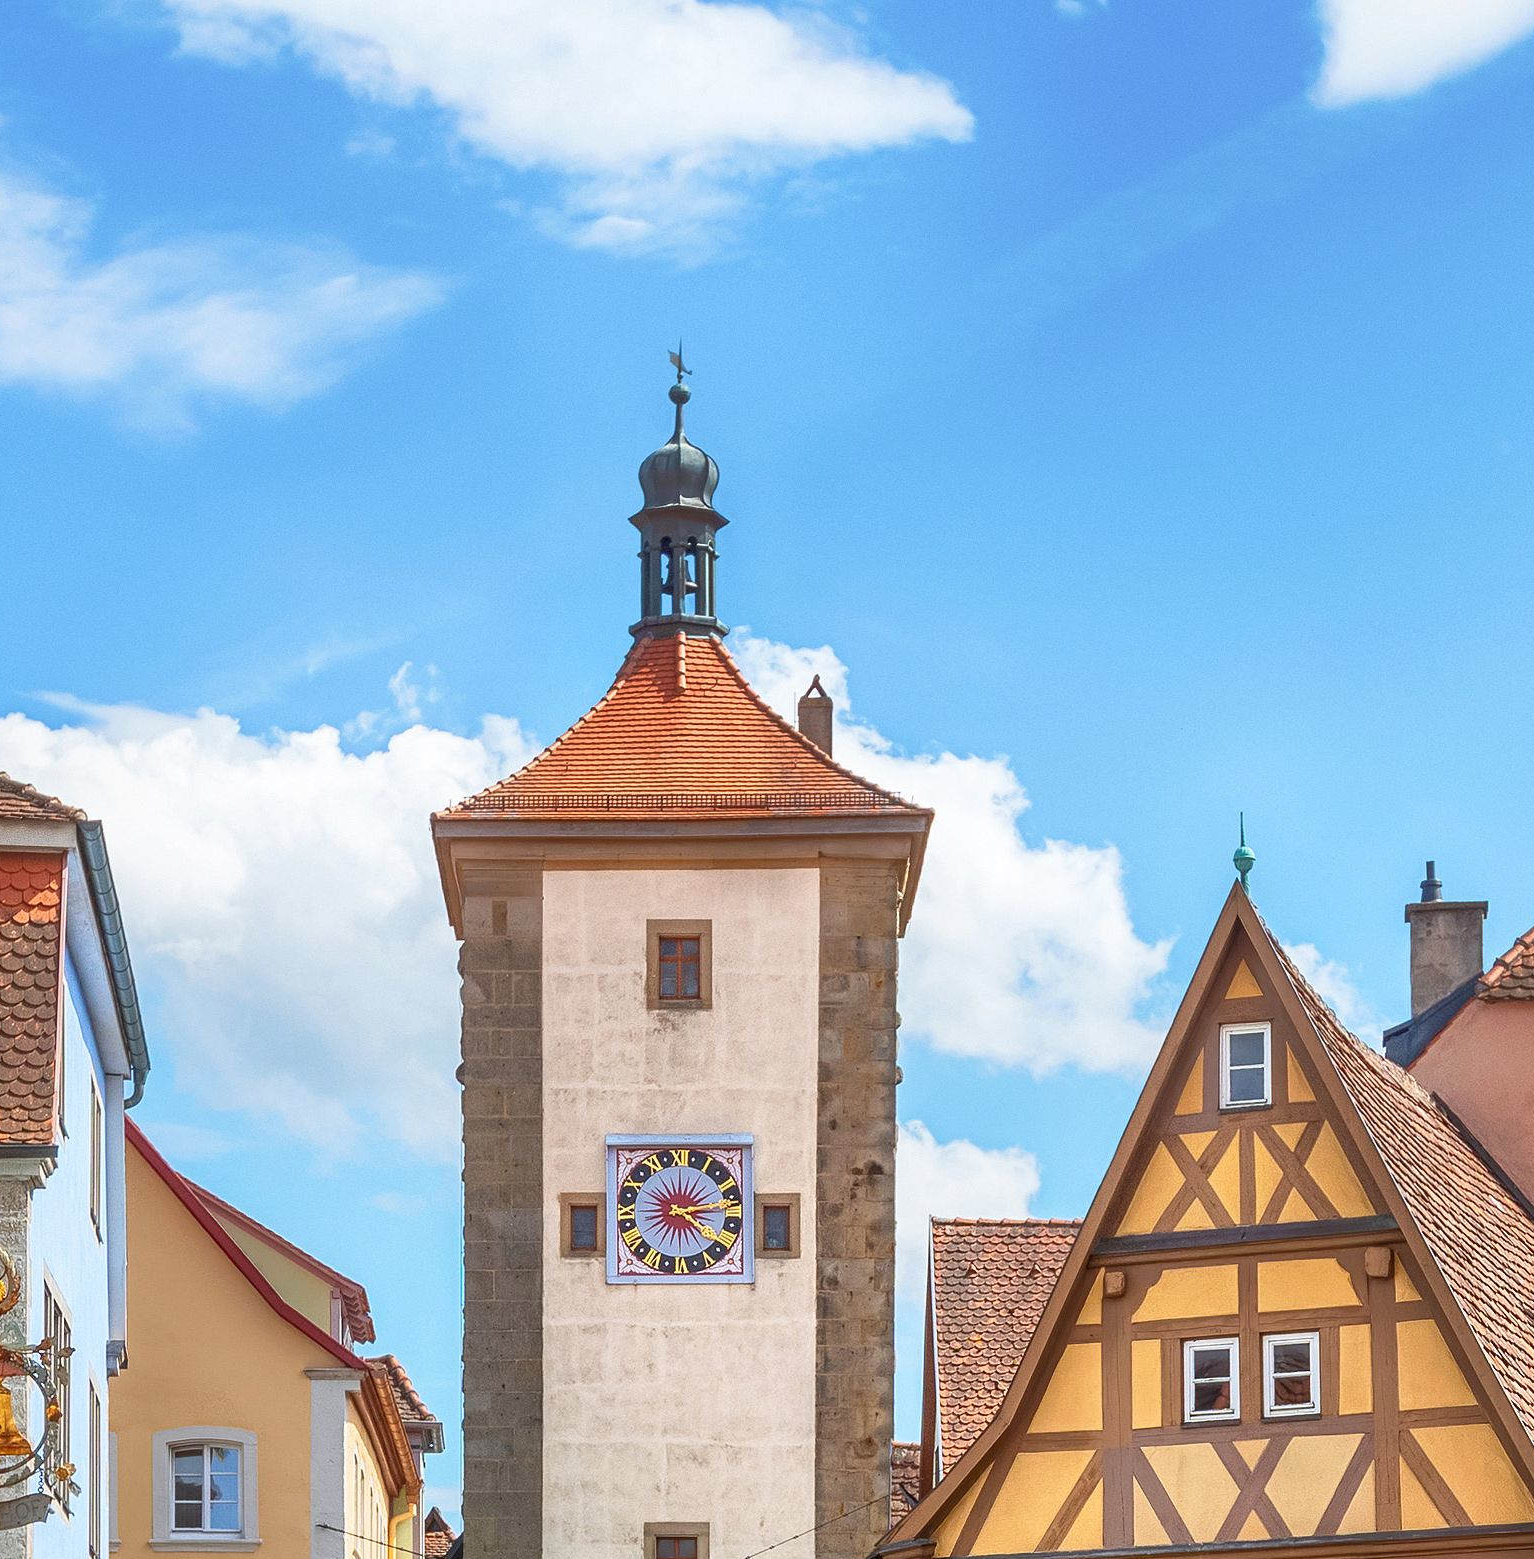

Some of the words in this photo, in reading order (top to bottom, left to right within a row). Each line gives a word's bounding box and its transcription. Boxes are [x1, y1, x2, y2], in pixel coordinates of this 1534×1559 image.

[642, 1154, 664, 1175] XI
[669, 1149, 690, 1167] XII
[701, 1156, 713, 1173] I
[623, 1176, 643, 1192] X
[718, 1176, 736, 1192] II
[617, 1203, 635, 1221] IX
[622, 1227, 643, 1251] VIII
[717, 1229, 738, 1249] IIII
[642, 1248, 662, 1269] VII
[674, 1256, 689, 1274] VI
[703, 1251, 716, 1267] V
